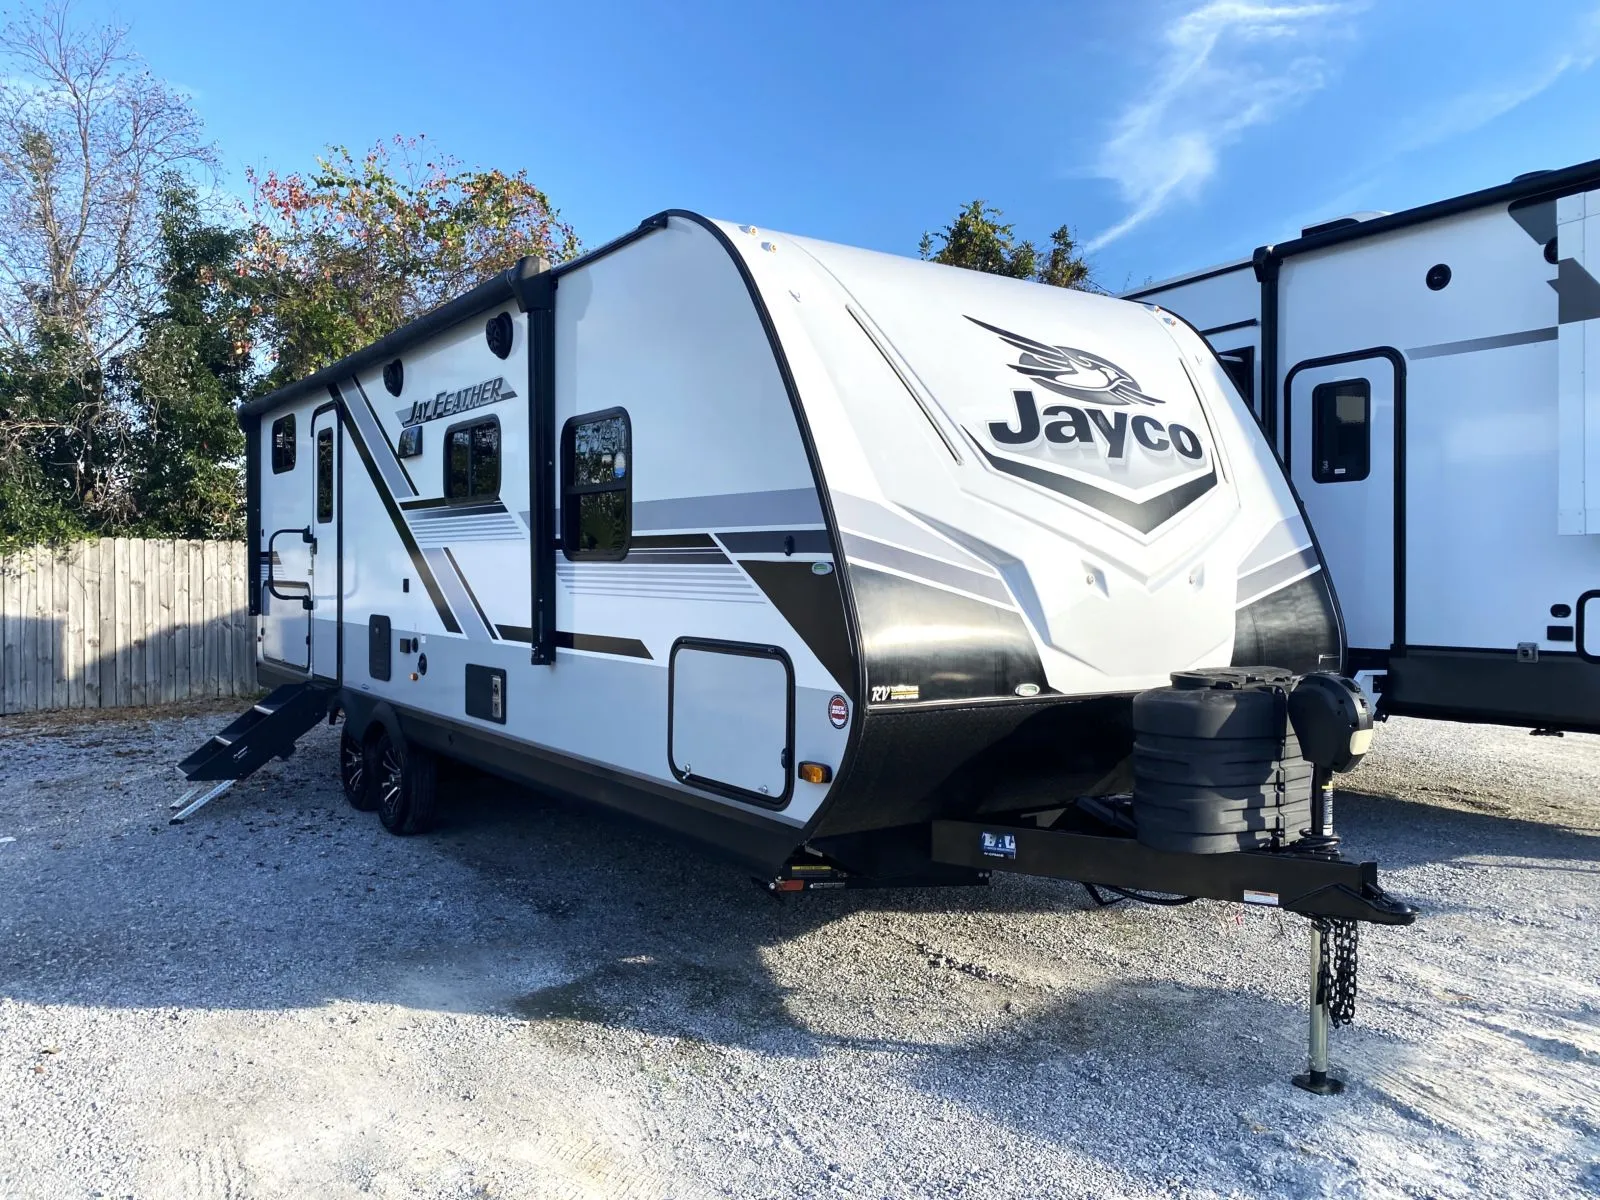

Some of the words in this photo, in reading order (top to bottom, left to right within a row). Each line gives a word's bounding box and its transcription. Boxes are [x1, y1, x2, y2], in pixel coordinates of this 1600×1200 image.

[404, 399, 431, 425] JAY
[432, 376, 504, 419] FEATHER
[988, 389, 1204, 461] Jayco
[872, 685, 891, 702] RV
